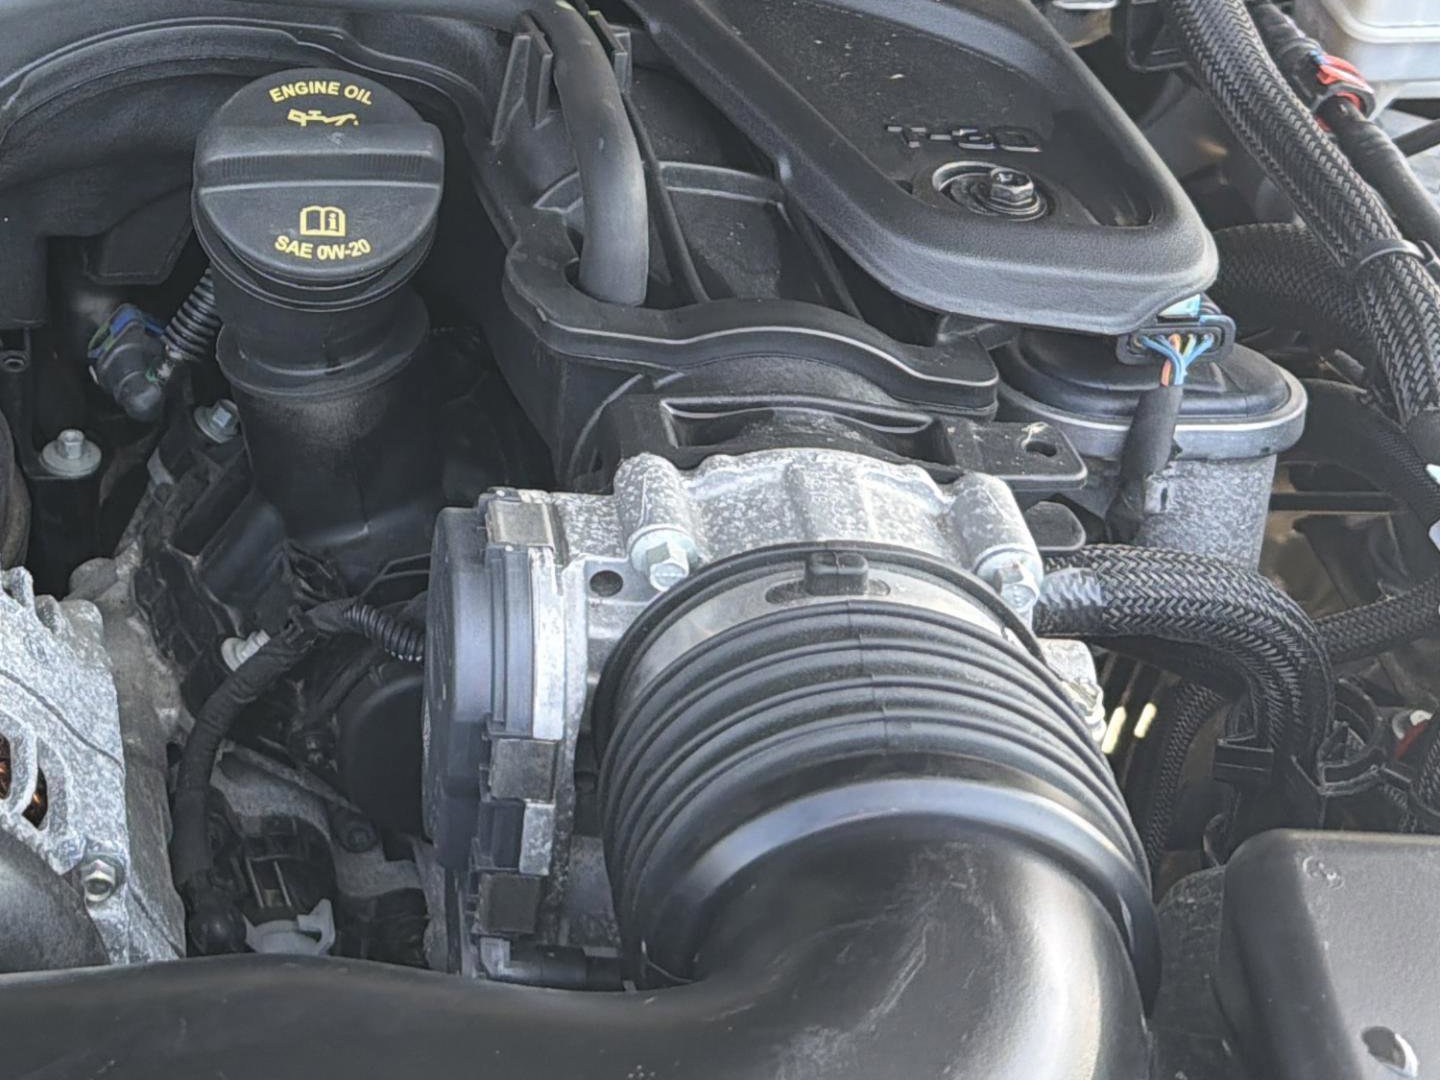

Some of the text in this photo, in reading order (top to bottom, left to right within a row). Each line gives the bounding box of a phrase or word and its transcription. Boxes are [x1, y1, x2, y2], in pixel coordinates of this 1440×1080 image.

[269, 80, 373, 105] ENGINE OIL
[274, 235, 372, 261] SAE 0W-20
